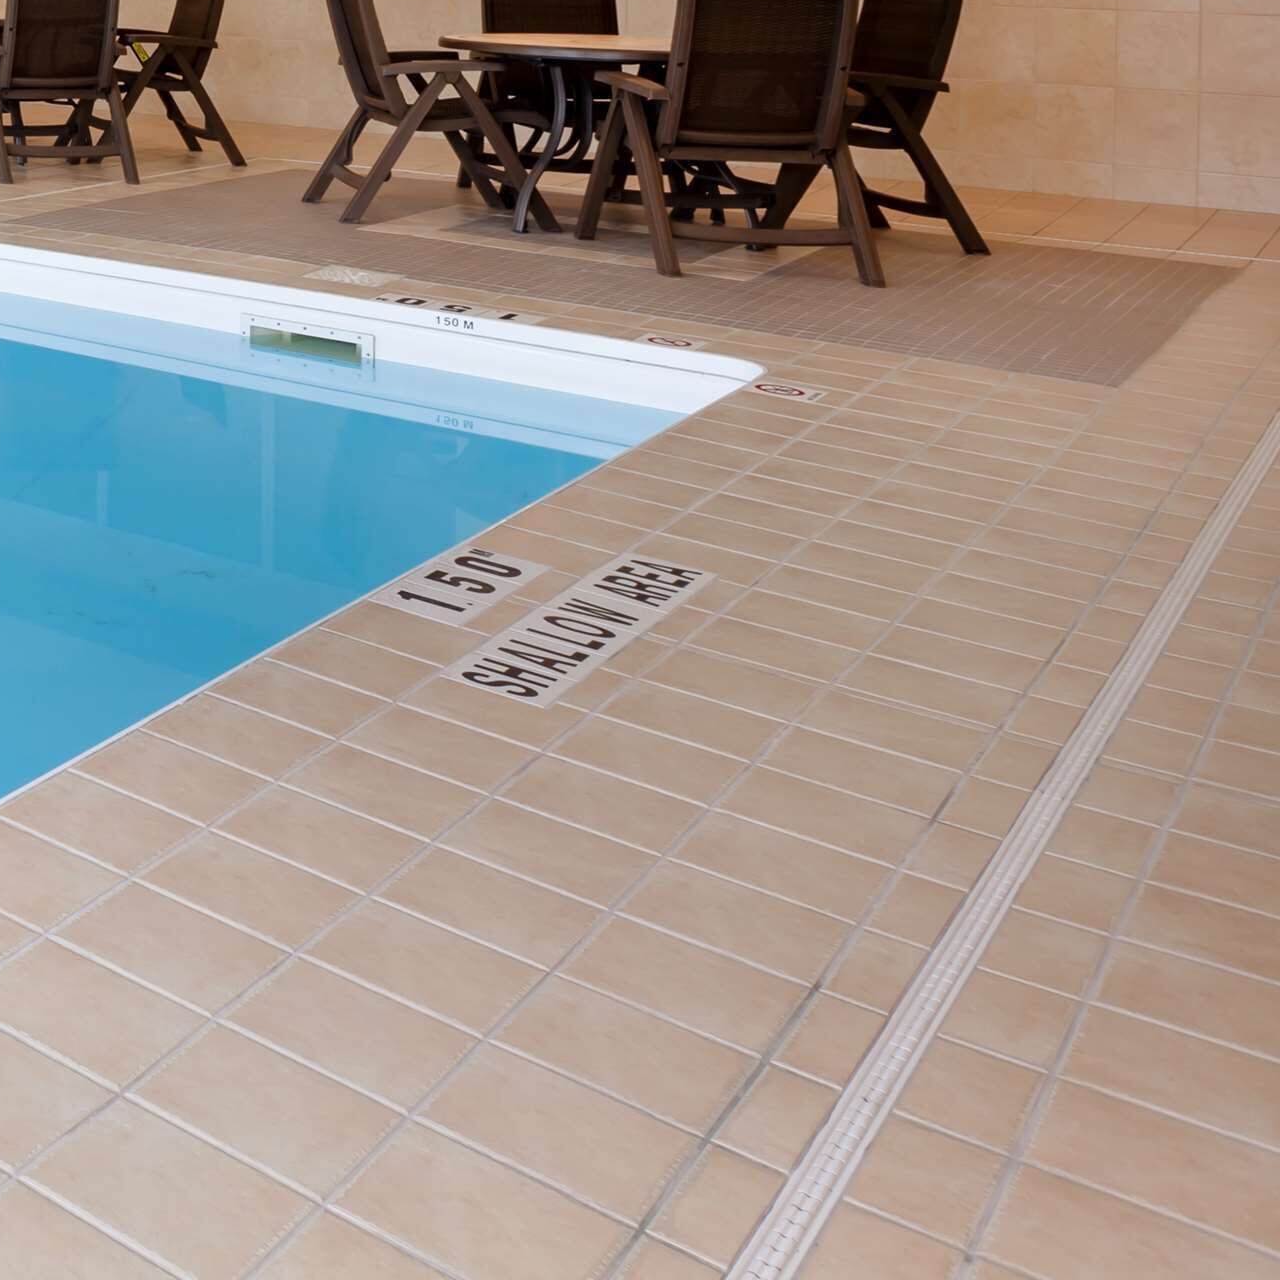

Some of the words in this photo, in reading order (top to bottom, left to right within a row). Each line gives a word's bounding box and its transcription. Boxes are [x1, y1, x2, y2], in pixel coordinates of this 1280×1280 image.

[464, 320, 474, 330] M
[461, 597, 640, 698] SHALLOW
[593, 559, 703, 608] AREA
